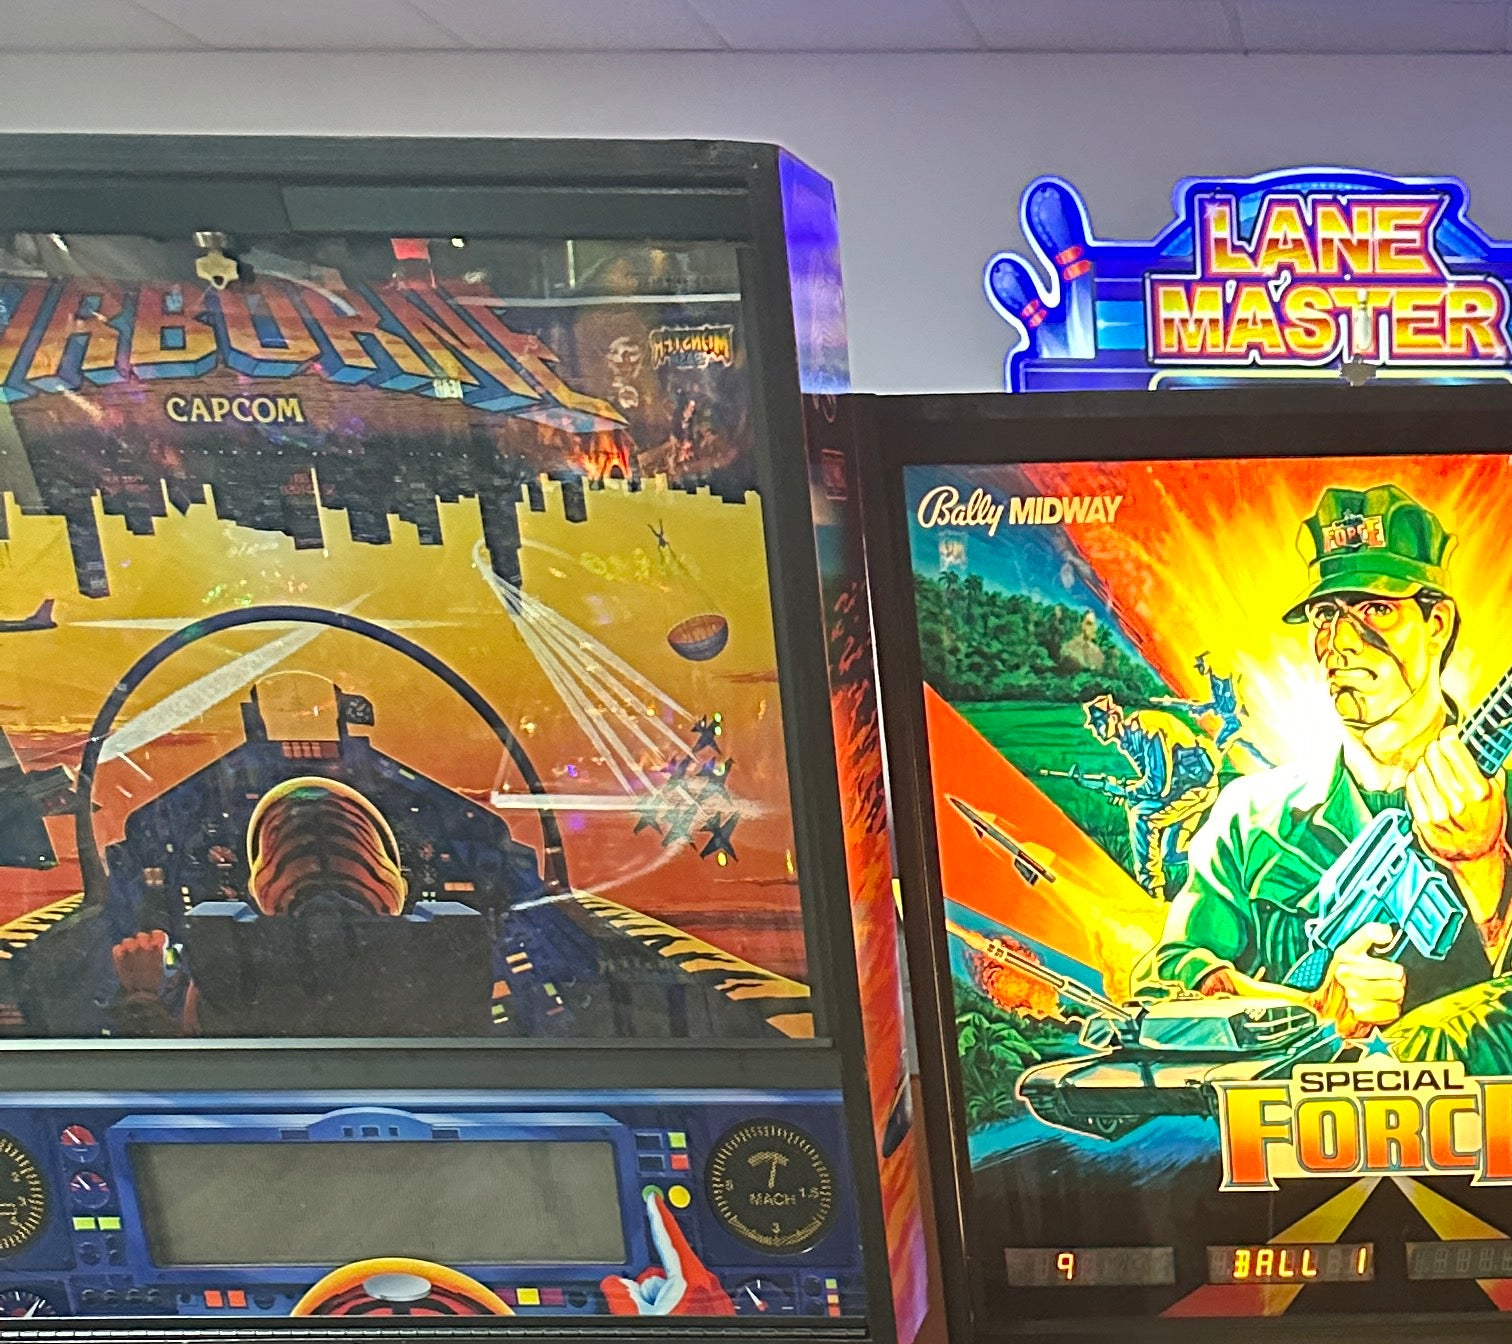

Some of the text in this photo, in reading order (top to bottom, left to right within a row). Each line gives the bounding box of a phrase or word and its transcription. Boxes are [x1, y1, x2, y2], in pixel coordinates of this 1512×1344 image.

[1210, 203, 1433, 275] LANE
[1157, 286, 1502, 354] MASTER
[0, 275, 630, 434] IRBORNE
[167, 396, 305, 424] CAPCOM
[917, 485, 1123, 537] Bally MIDWAY
[1300, 1068, 1465, 1092] SPECIAL
[750, 1193, 796, 1206] MACH
[1056, 1252, 1075, 1280] 9
[1234, 1247, 1367, 1279] BALL 1
